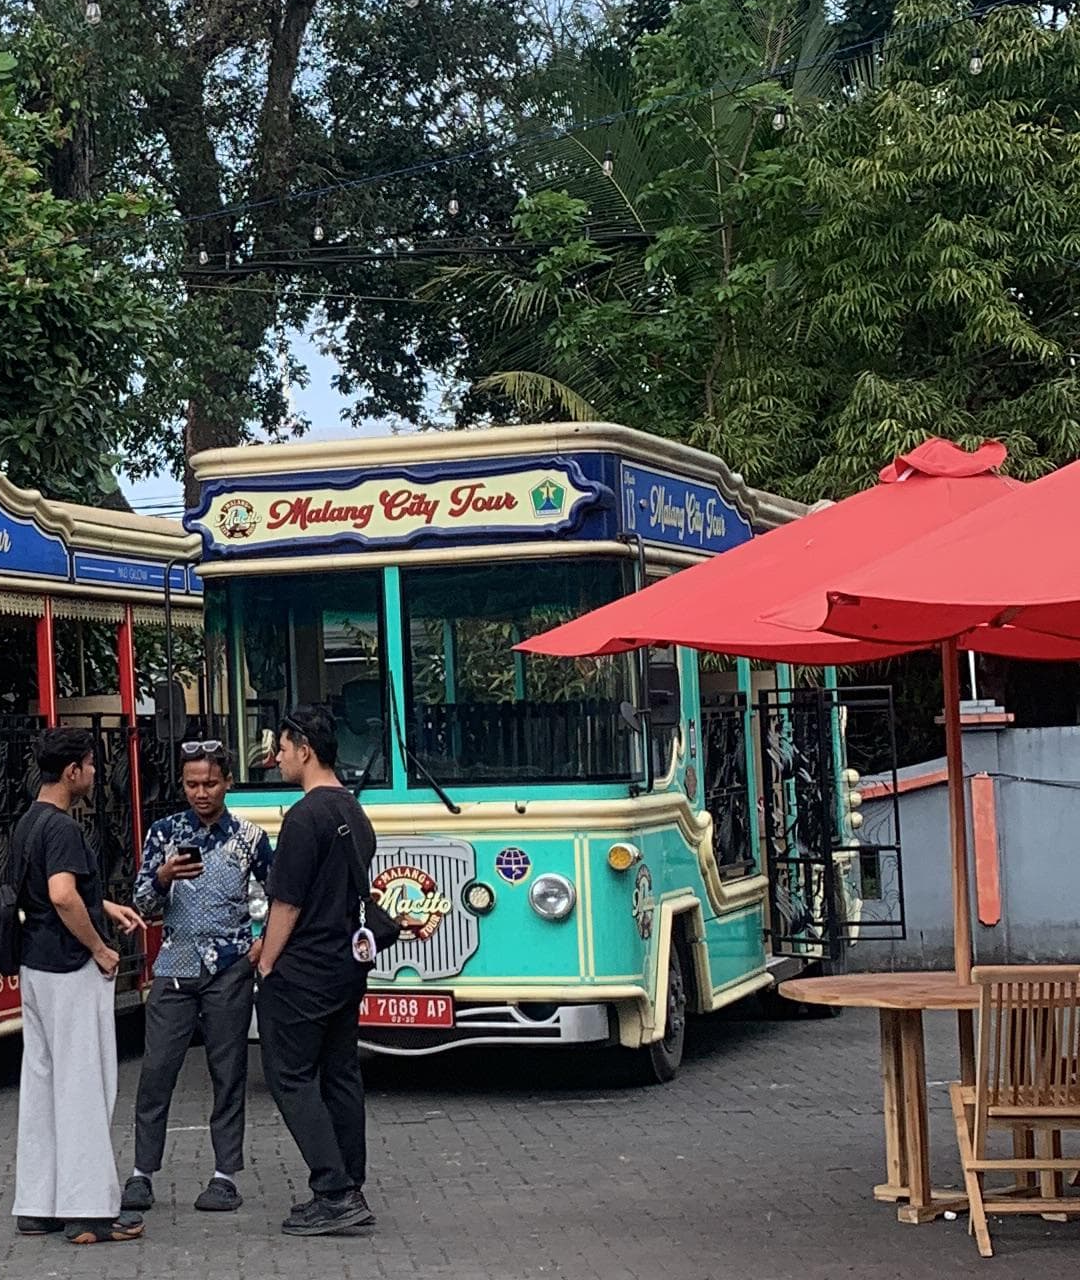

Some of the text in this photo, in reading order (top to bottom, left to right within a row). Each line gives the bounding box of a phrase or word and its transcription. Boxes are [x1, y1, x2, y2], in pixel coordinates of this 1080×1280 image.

[266, 497, 373, 530] Malang
[379, 488, 439, 524] City
[449, 482, 519, 516] Tour
[650, 484, 726, 545] Malang City Tour
[380, 867, 427, 884] MALANG
[370, 887, 452, 919] Macito
[422, 914, 441, 937] TOUR
[360, 998, 447, 1018] N 7088 AP
